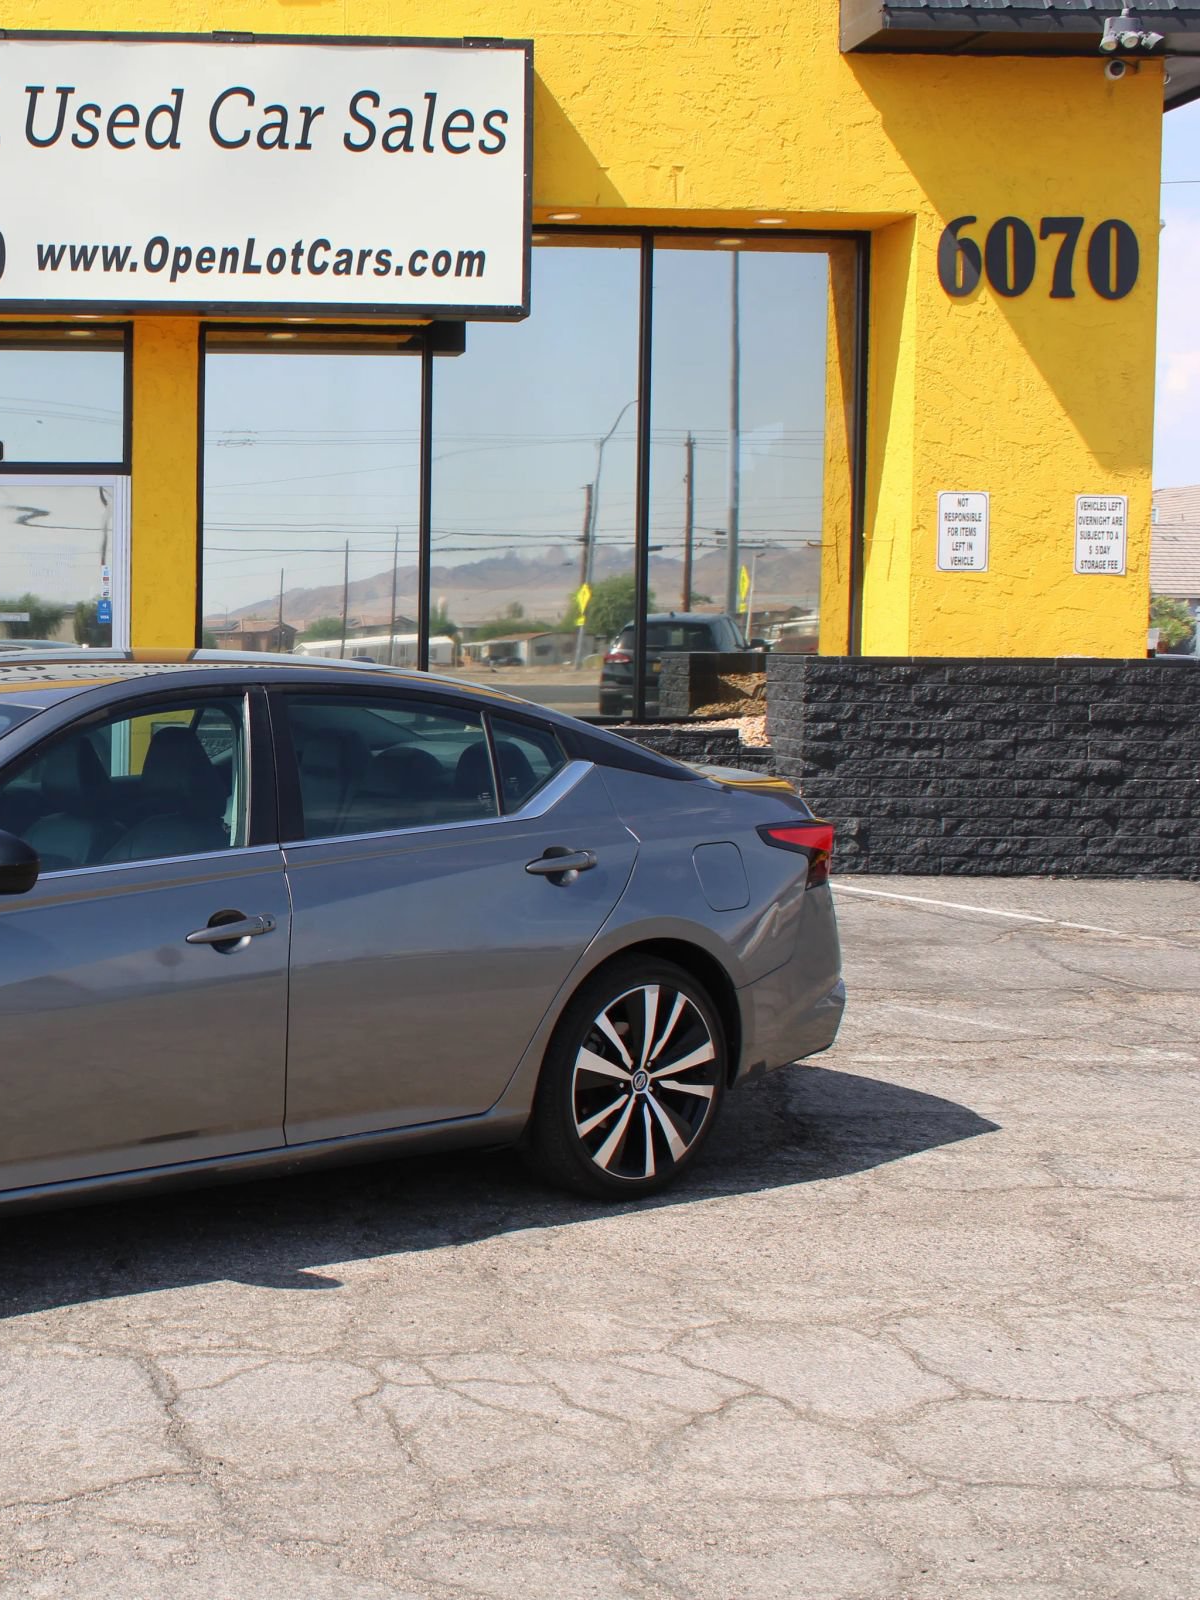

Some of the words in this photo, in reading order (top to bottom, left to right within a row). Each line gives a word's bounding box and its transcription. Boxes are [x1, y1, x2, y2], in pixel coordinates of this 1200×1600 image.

[23, 85, 185, 151] Used
[208, 85, 325, 152] Car
[342, 89, 510, 155] Sales
[35, 235, 487, 283] www.OpenLotCars.com
[937, 215, 1141, 300] 6070
[957, 498, 969, 507] NOT
[1079, 501, 1107, 511] VEHICLES
[1108, 502, 1121, 511] LEFT
[944, 512, 982, 522] RESPONSIBLE
[1078, 516, 1110, 526] OVERNIGHT
[1111, 516, 1123, 526] ARE
[947, 527, 958, 536] FOR
[959, 527, 976, 536] ITEMS
[1079, 531, 1105, 540] SUBJECT
[1106, 531, 1113, 540] TO
[952, 542, 965, 551] LEFT
[967, 542, 973, 551] IN
[950, 556, 974, 566] VEHICLE
[1080, 560, 1106, 570] STORAGE
[1107, 560, 1118, 570] FEE
